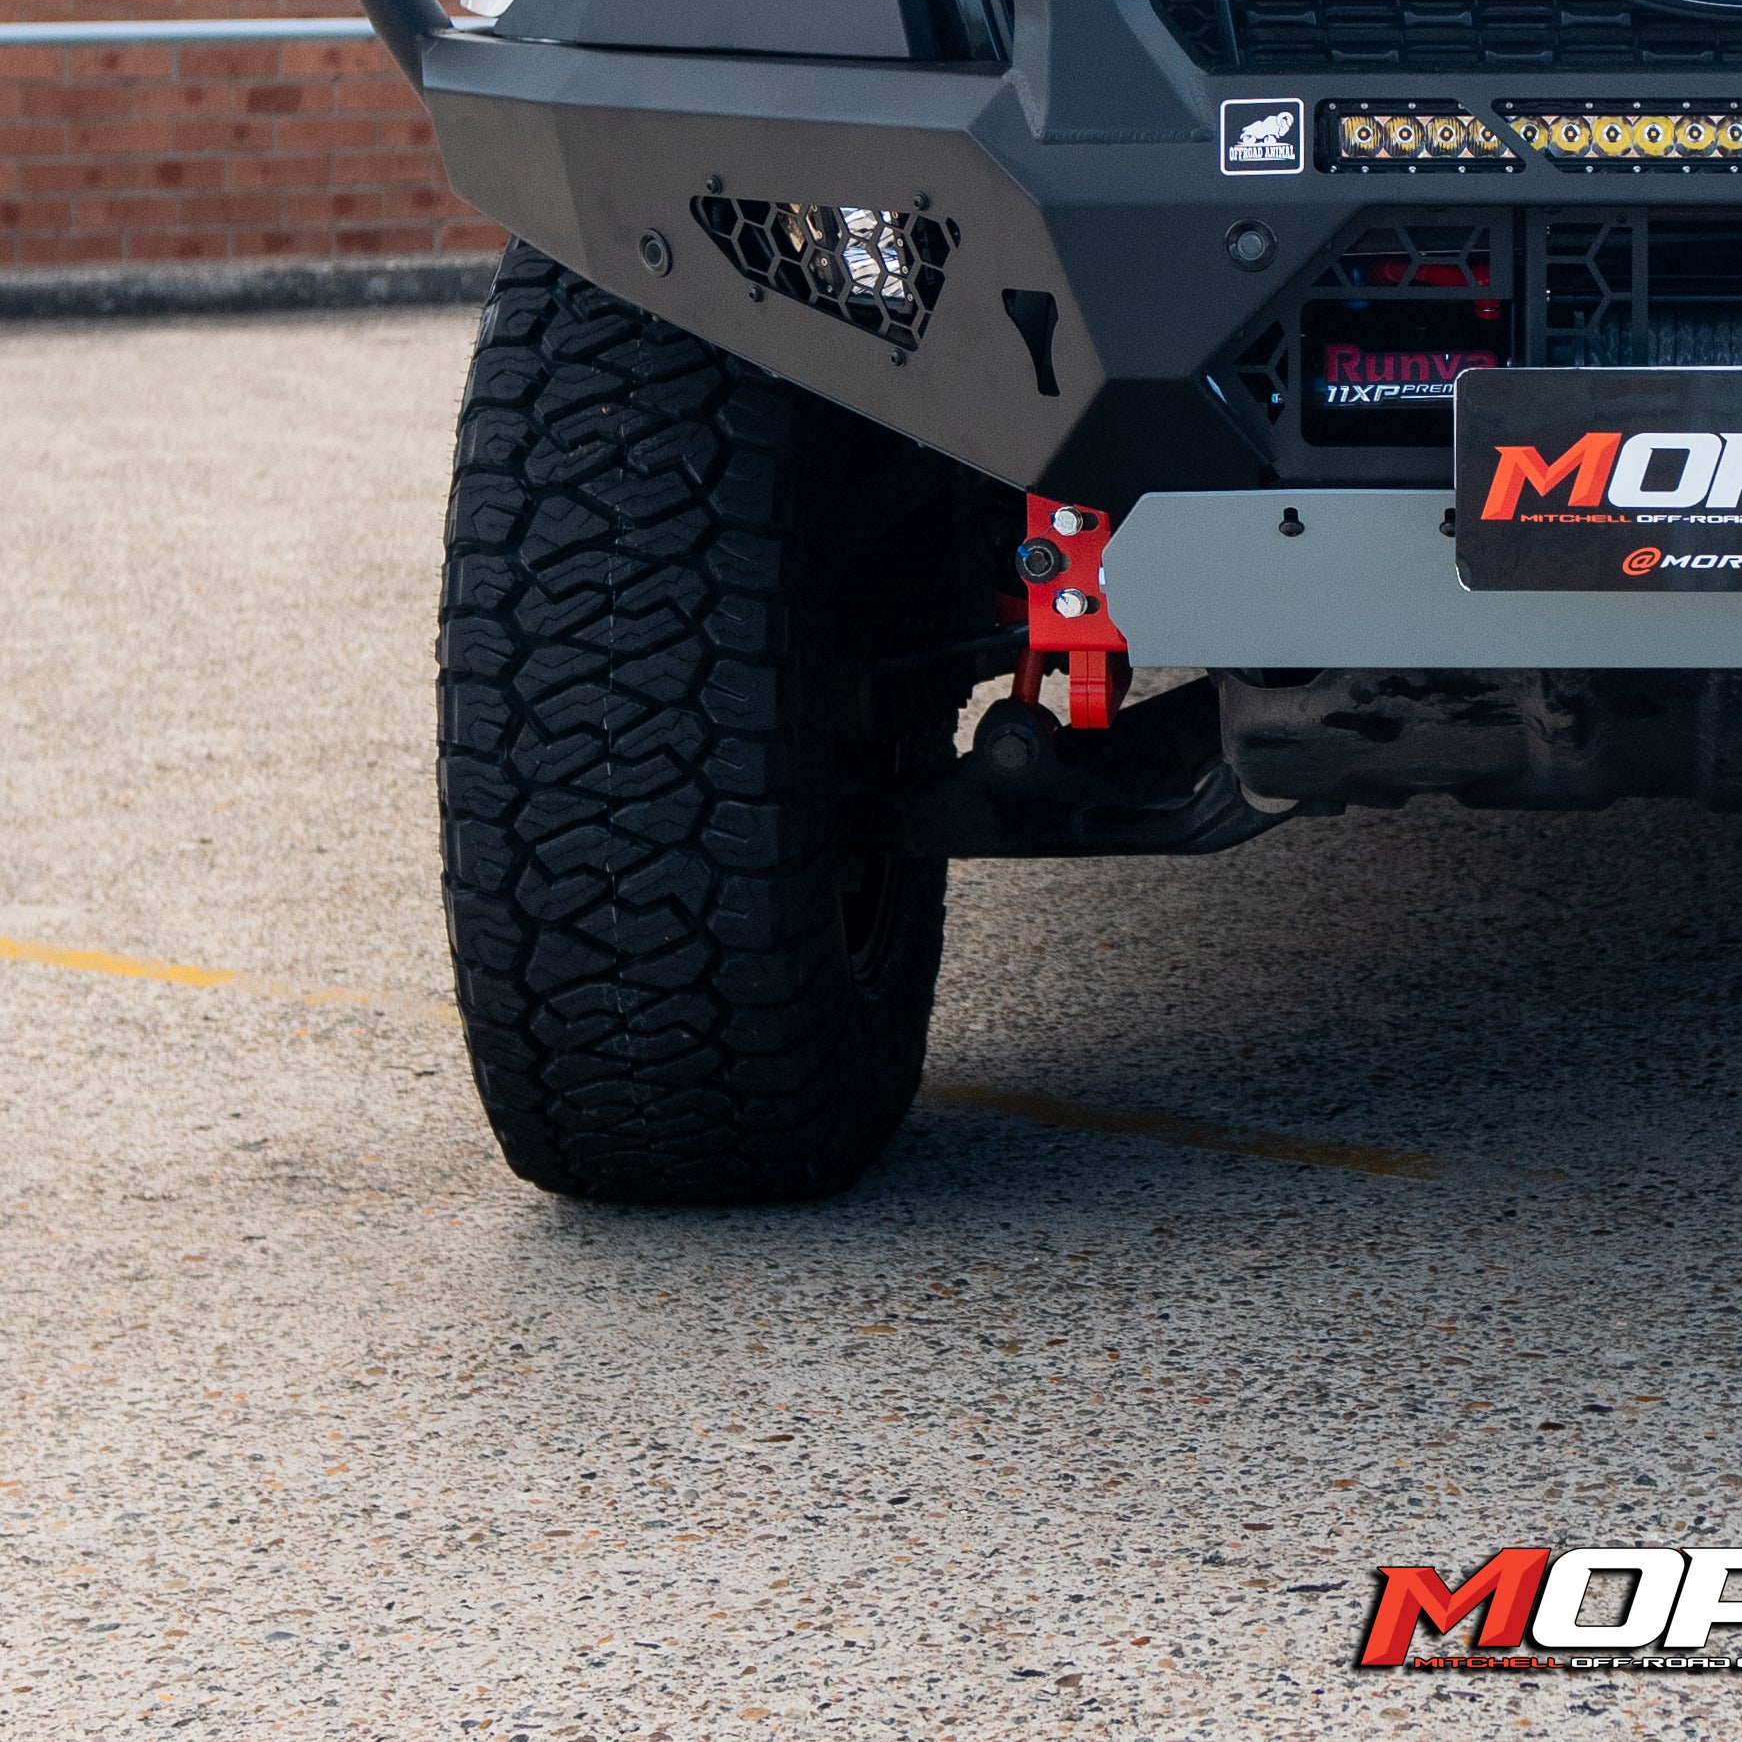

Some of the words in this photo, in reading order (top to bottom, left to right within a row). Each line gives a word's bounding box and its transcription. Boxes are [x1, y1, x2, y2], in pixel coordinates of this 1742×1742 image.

[1228, 146, 1263, 162] OFFROAD
[1264, 145, 1296, 160] ANIMAL
[1519, 513, 1632, 523] MITCHELL
